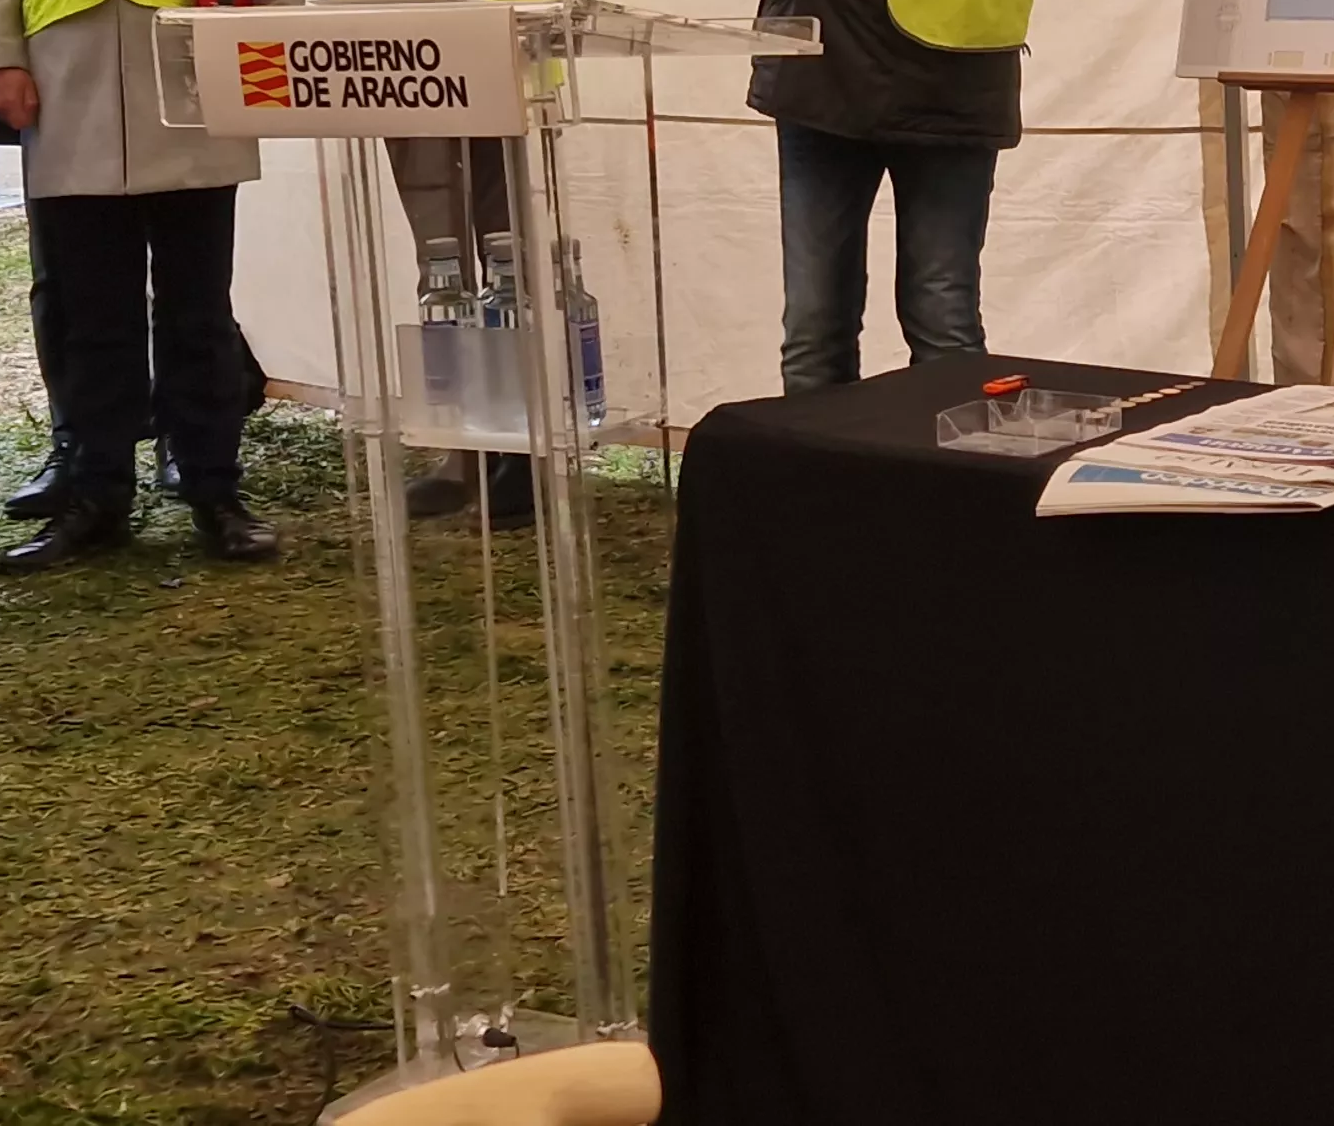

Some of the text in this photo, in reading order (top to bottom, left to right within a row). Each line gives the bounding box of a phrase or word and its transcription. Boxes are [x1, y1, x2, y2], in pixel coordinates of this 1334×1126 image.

[289, 38, 441, 72] GOBIERNO
[292, 75, 469, 109] DE ARAGON
